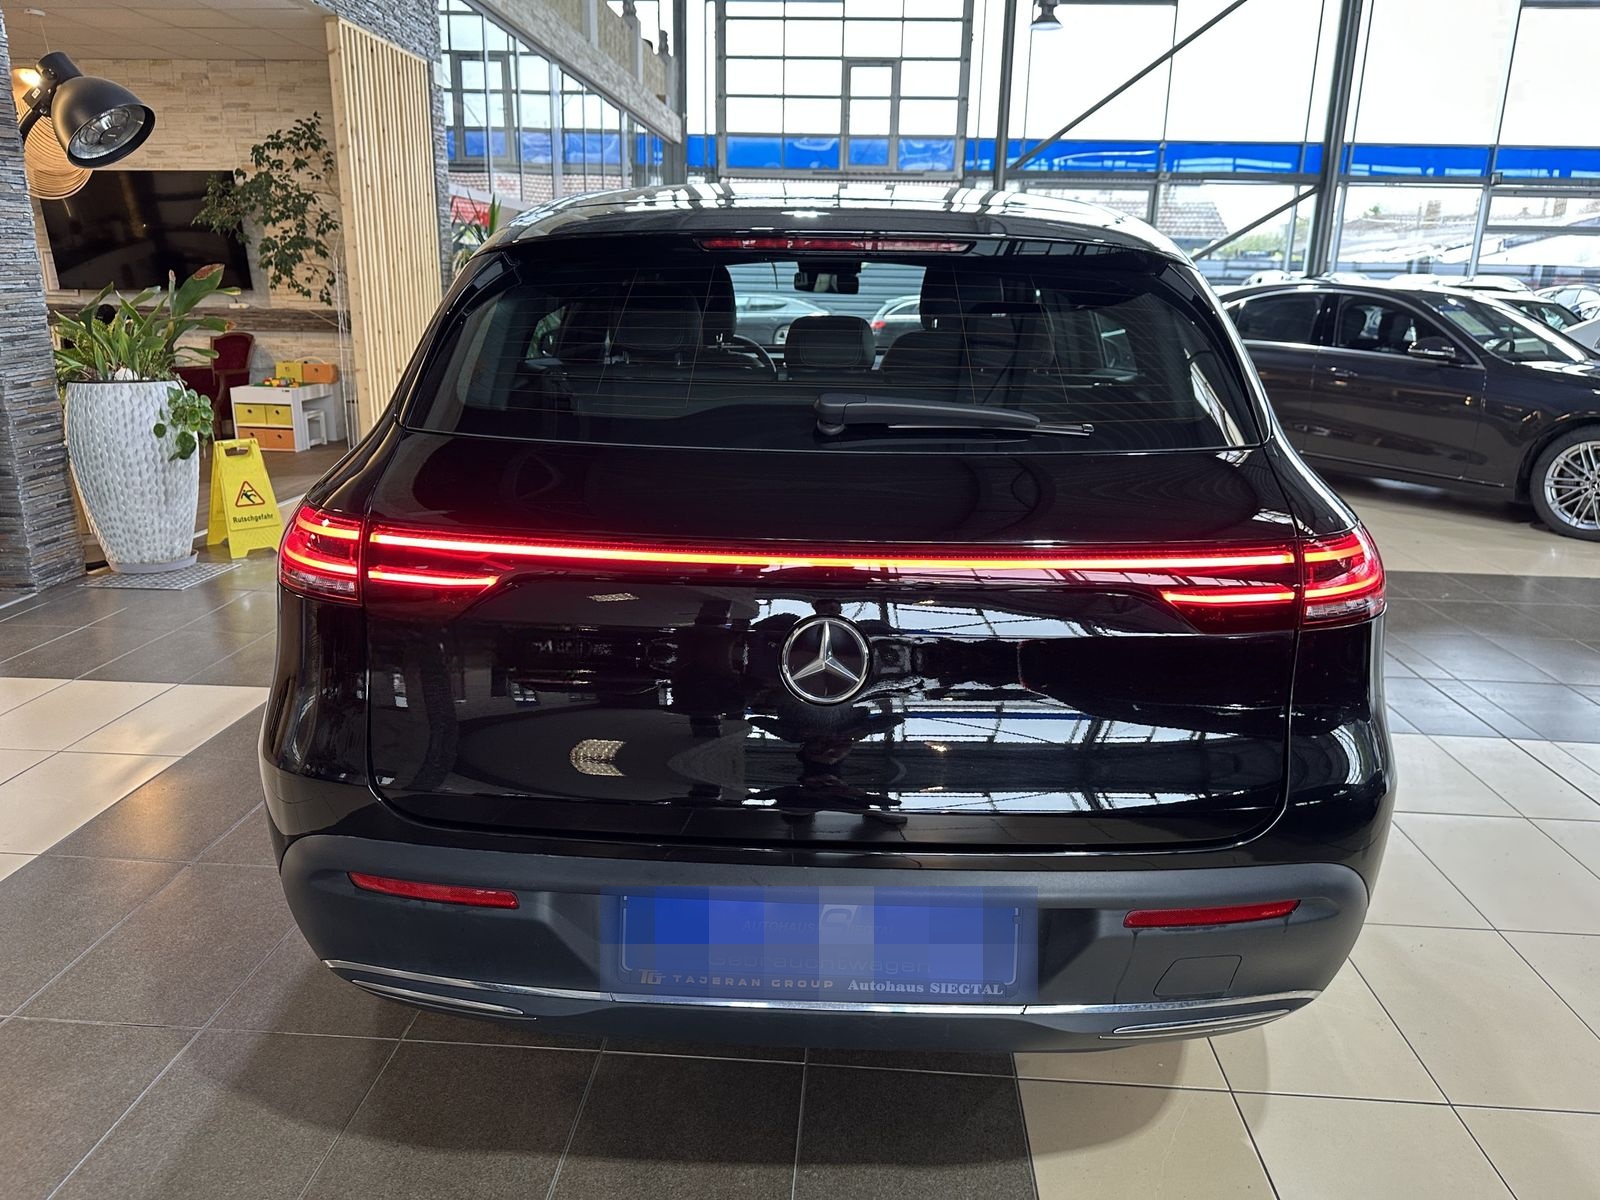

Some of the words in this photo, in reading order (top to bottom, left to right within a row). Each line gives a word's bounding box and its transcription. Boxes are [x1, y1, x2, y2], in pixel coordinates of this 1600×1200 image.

[232, 513, 273, 523] Rutschgefahr
[742, 920, 816, 934] AUTOHAUS
[708, 951, 930, 974] Gebrauchtwagen
[673, 974, 761, 987] TAJERAN
[771, 979, 833, 988] GROUP
[848, 979, 924, 993] Autohaus
[929, 982, 1003, 995] SIEGTAL
